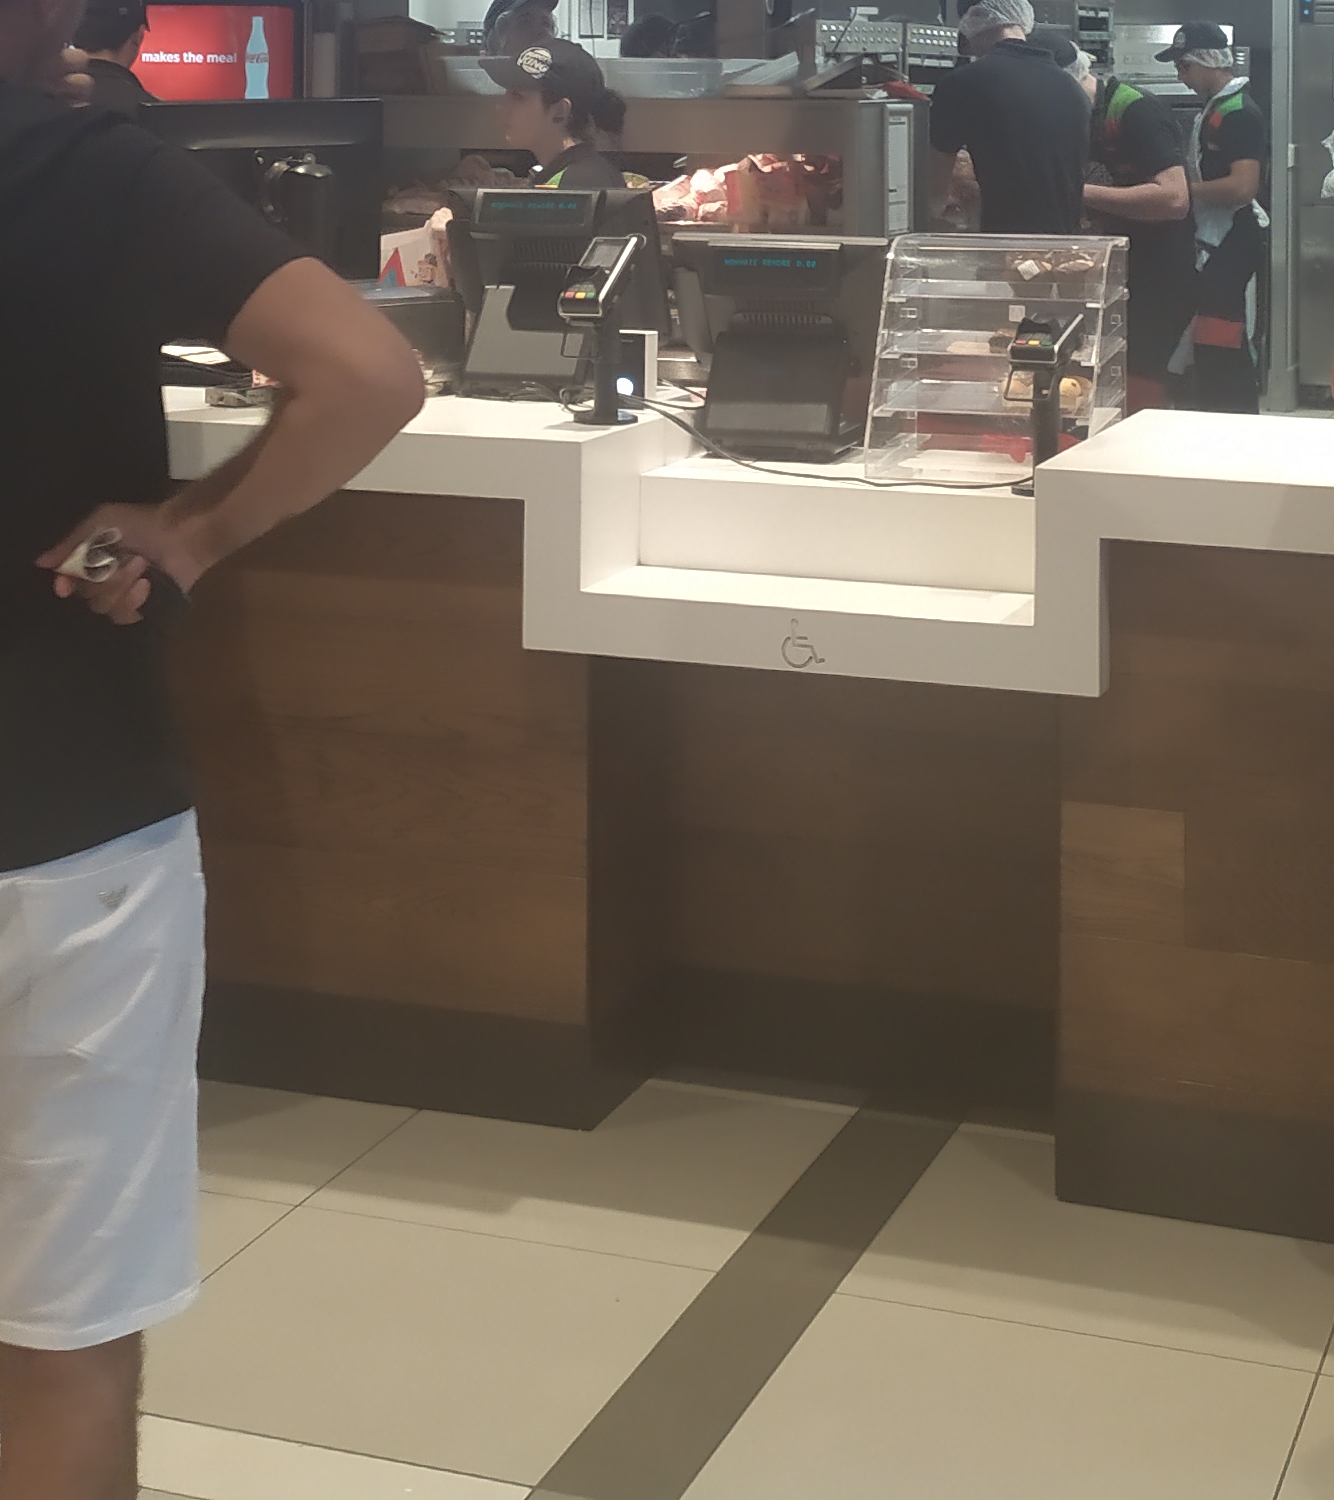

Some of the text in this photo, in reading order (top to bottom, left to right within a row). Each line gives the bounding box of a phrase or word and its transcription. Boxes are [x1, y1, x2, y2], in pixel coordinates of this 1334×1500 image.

[141, 51, 237, 63] makes the meal
